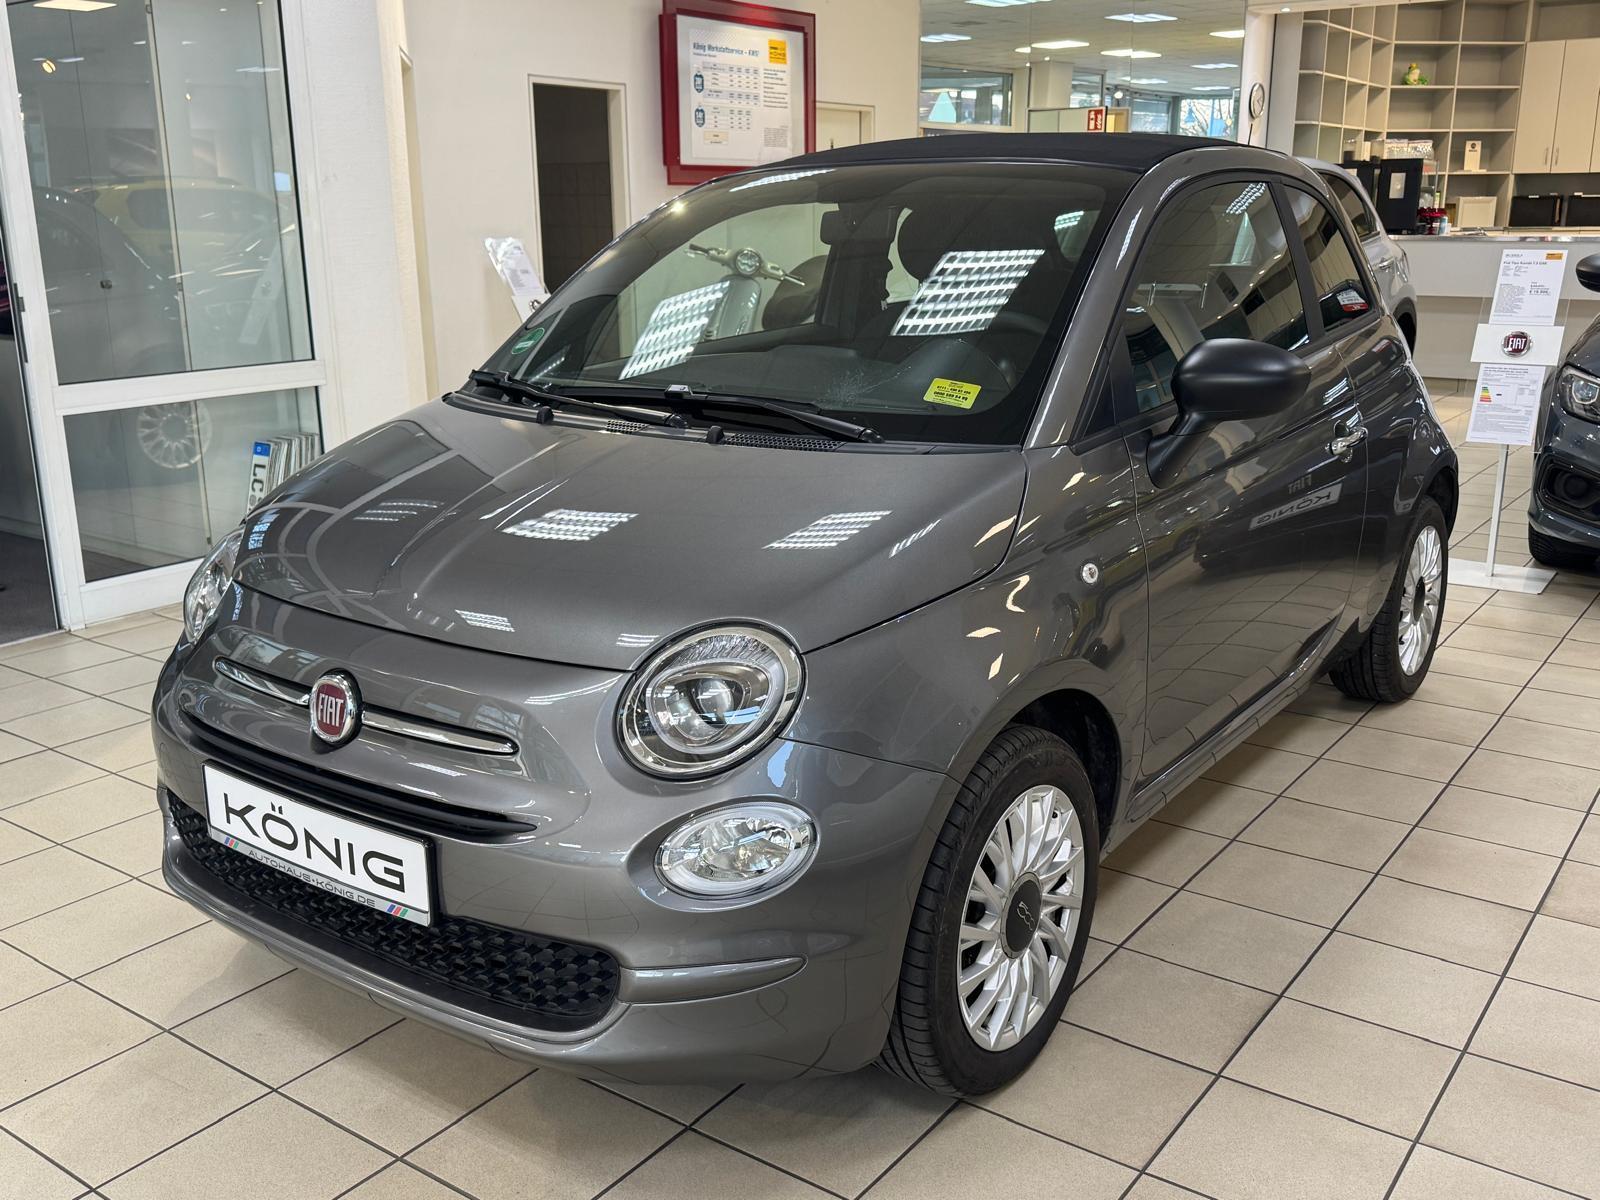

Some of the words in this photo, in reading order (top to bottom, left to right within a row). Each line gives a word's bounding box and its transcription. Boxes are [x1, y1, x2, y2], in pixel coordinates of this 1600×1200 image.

[1508, 337, 1526, 350] FIAT
[318, 692, 344, 727] FIAT
[223, 792, 406, 893] KÖNIG
